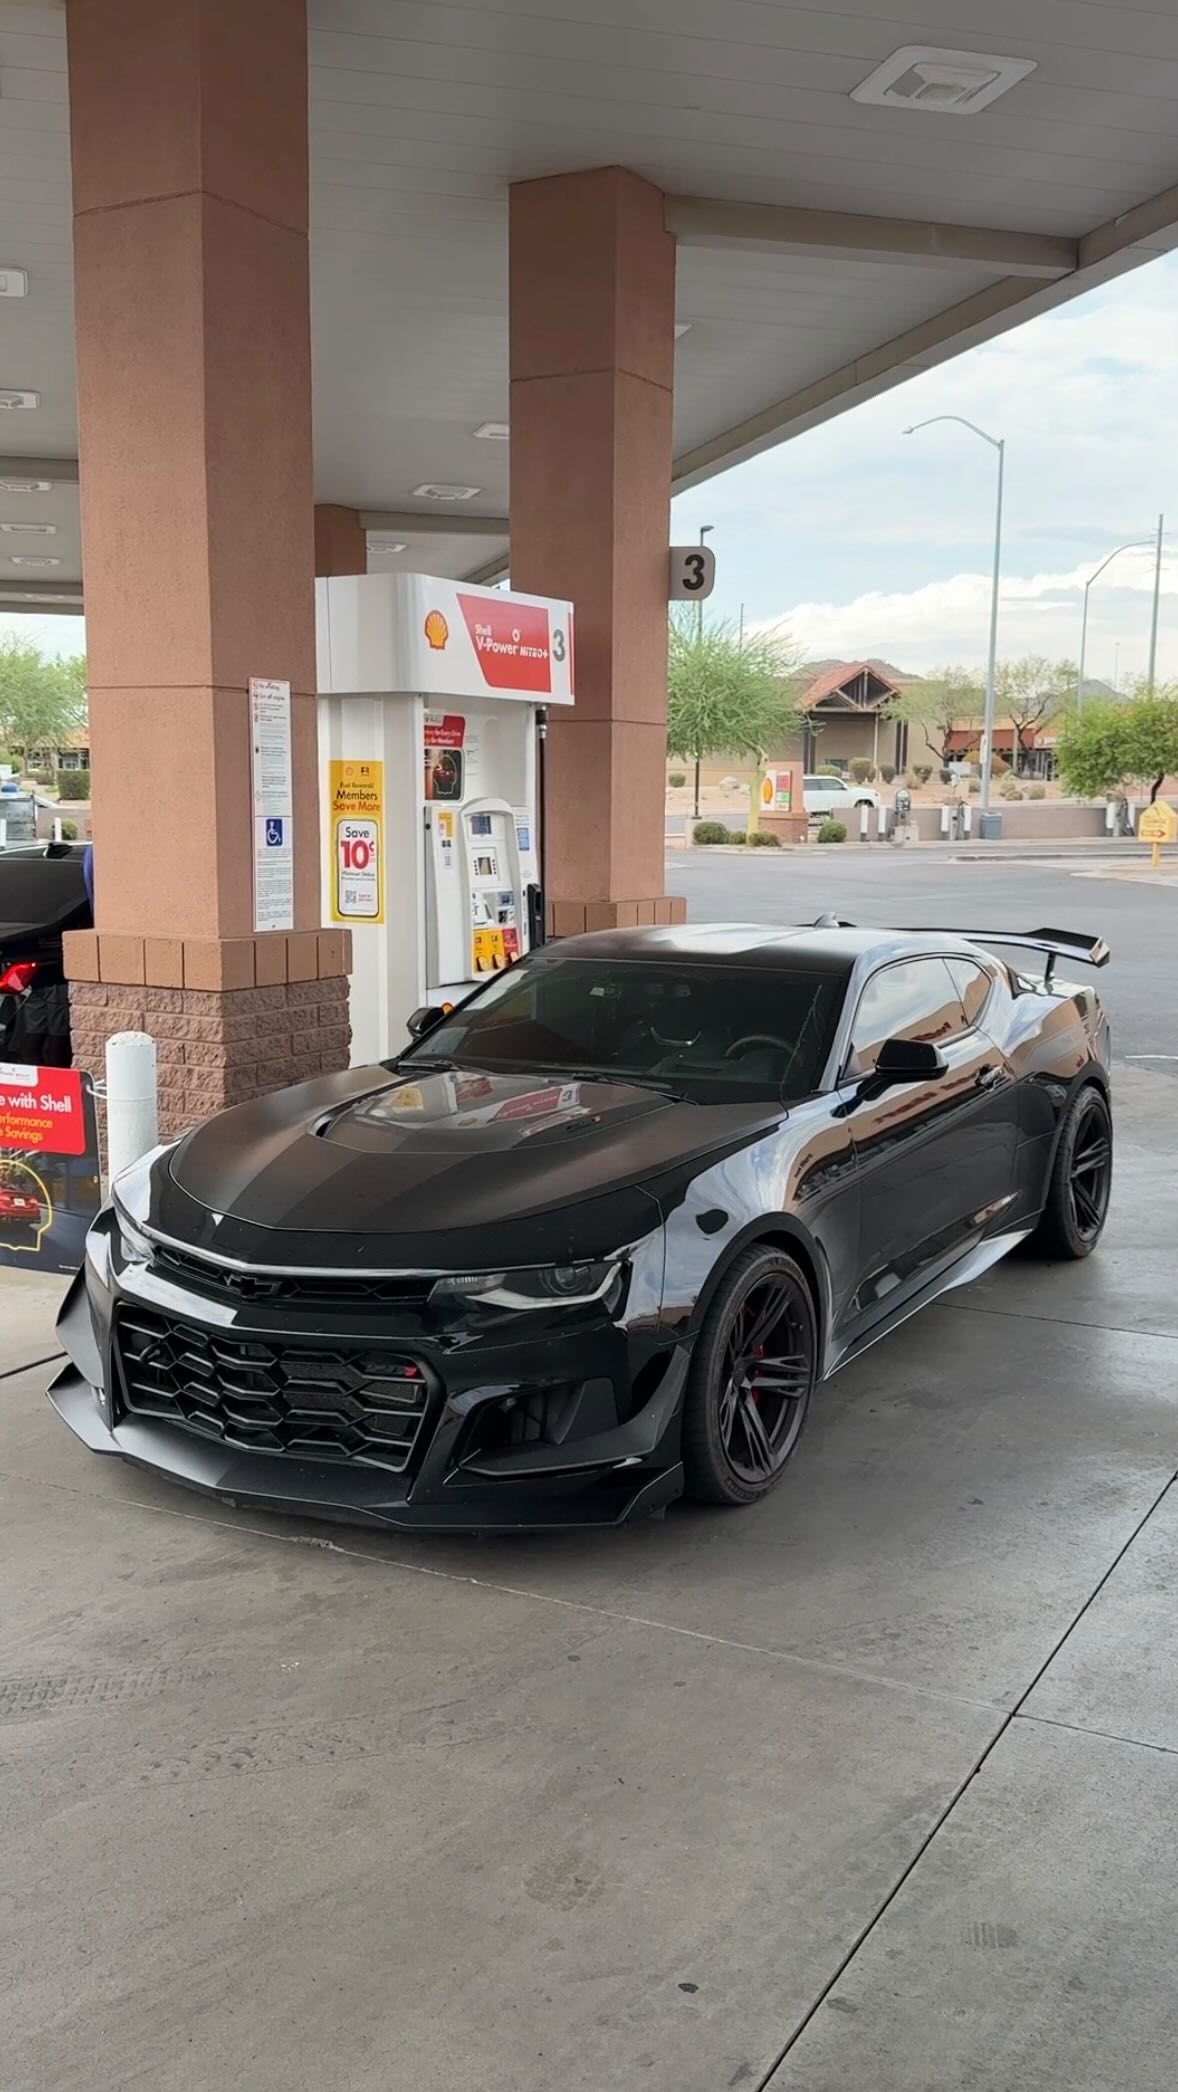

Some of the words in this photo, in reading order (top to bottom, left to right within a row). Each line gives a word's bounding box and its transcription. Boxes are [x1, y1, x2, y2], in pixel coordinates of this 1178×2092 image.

[682, 554, 705, 590] 3
[474, 623, 492, 636] Shell
[475, 636, 519, 655] V-Power
[552, 629, 566, 662] 3
[336, 789, 378, 801] Members
[332, 800, 357, 811] Save
[358, 801, 380, 811] More
[345, 826, 370, 838] Save
[7, 1091, 37, 1109] with
[40, 1093, 72, 1113] Shell
[5, 1125, 43, 1144] Savings
